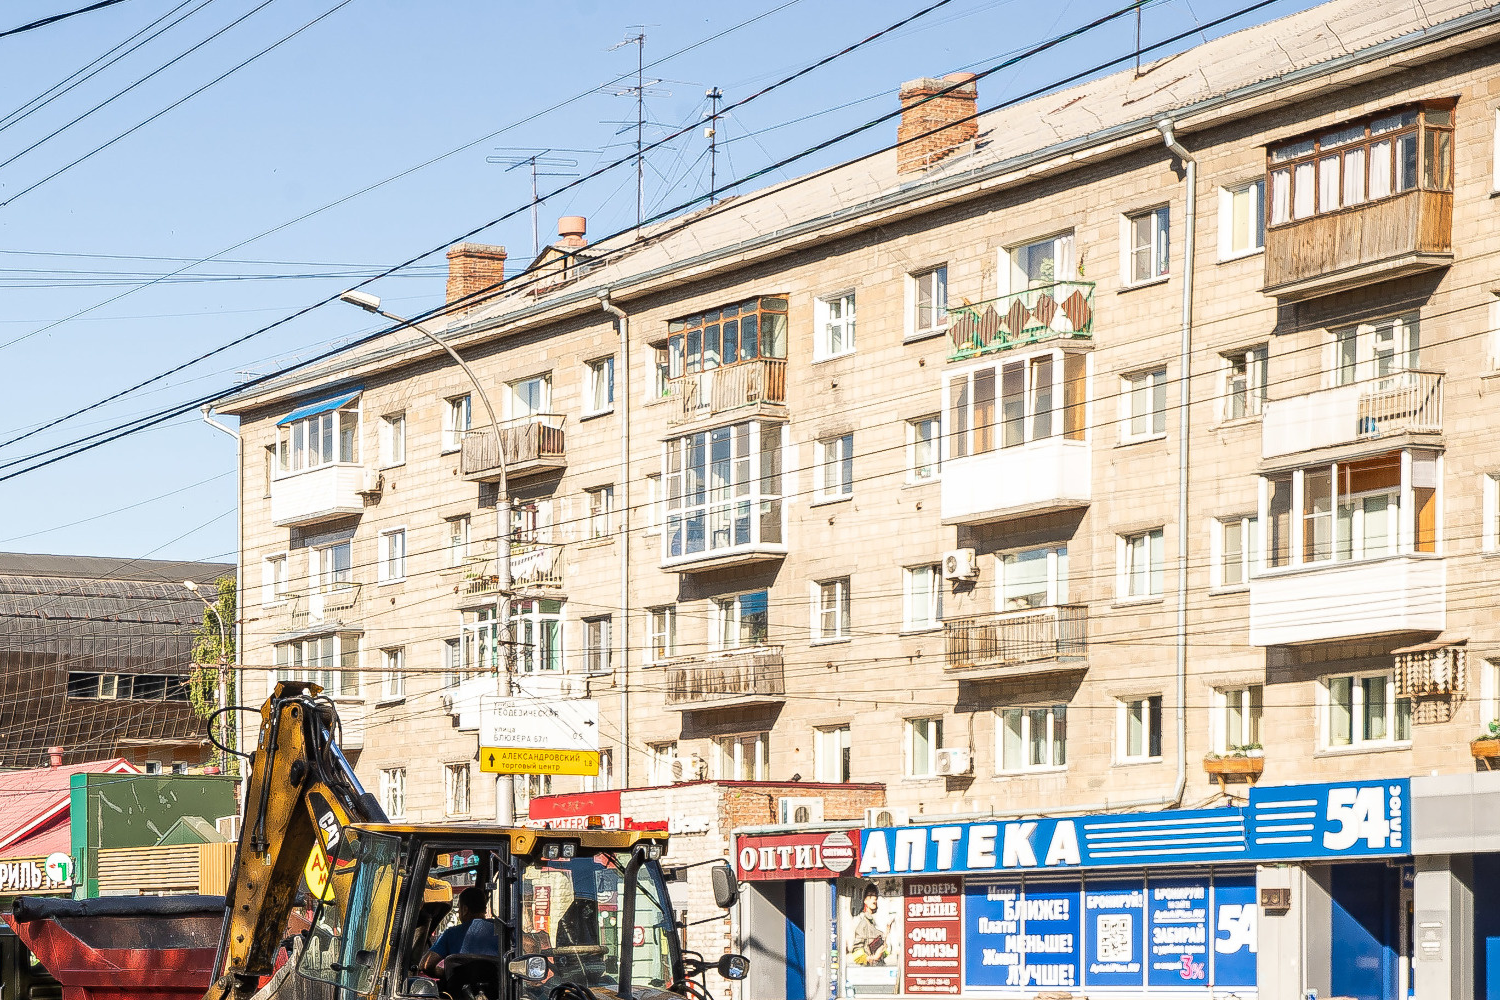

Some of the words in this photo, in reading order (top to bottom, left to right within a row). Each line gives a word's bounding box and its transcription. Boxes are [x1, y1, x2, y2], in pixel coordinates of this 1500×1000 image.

[493, 708, 559, 718] ГЕОДЕЗИЧЕСКАЯ
[493, 734, 531, 743] БЛЮХЕРА
[501, 752, 580, 762] АЛЕКСАНДРОВСКИЙ
[502, 762, 536, 770] торговый
[538, 762, 560, 771] центр
[1323, 786, 1390, 850] 54
[1389, 785, 1402, 848] ПЛЮС
[318, 810, 340, 850] CAT
[858, 820, 1082, 873] АПТЕКА
[909, 883, 958, 896] ПРОВЕРЬ
[908, 902, 958, 917] ЗРЕНИЕ
[1003, 898, 1070, 920] БЛИЖЕ!
[1005, 934, 1073, 953] МЕНЬШЕ!
[1152, 923, 1206, 944] ЗАБИРАЙ
[1006, 964, 1075, 986] ЛУЧШЕ!
[1180, 955, 1205, 980] 3%
